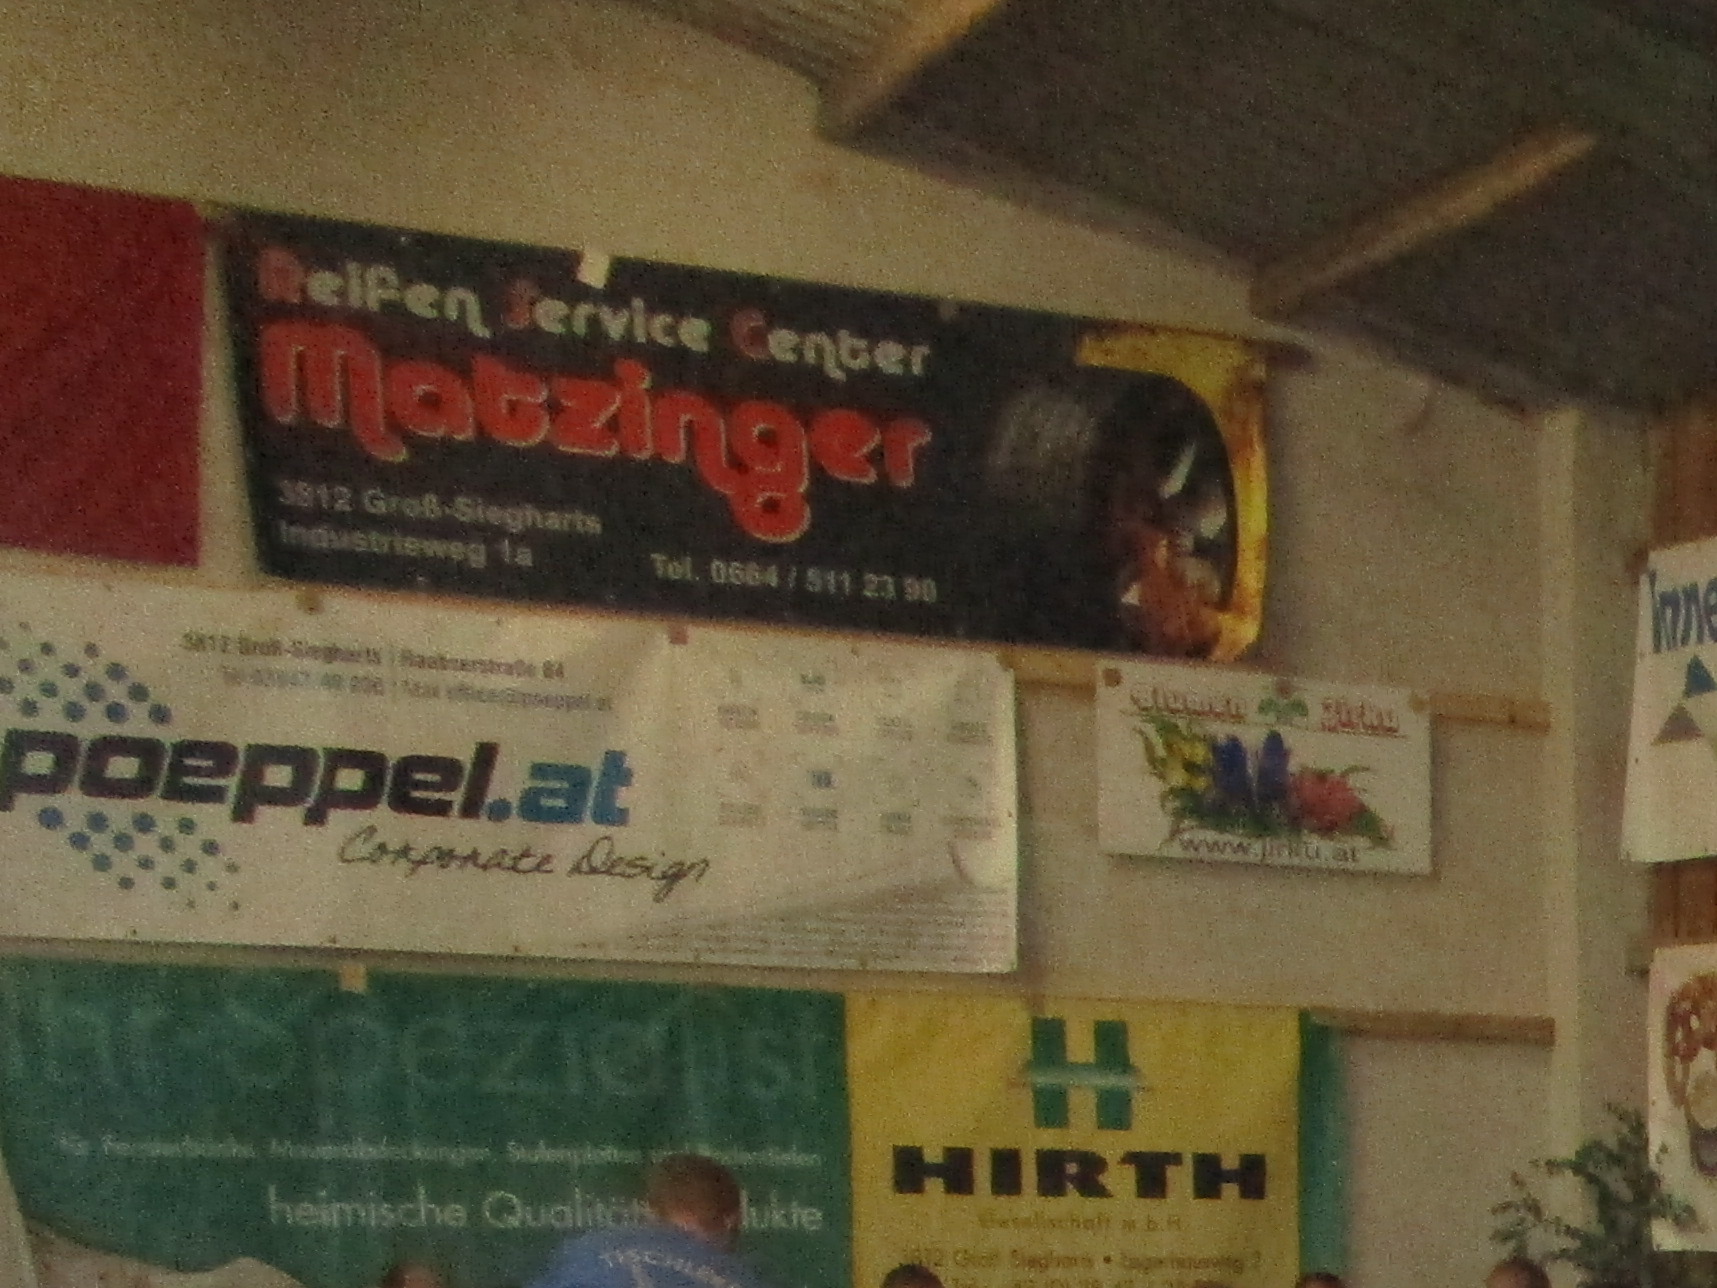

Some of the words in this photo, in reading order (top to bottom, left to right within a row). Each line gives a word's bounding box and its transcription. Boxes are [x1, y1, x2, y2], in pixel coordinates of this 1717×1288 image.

[259, 248, 491, 338] Reifen
[504, 279, 712, 352] Service
[729, 309, 931, 382] Center
[260, 319, 932, 544] Matzinger
[649, 552, 702, 582] Tel.
[0, 727, 634, 827] poeppel.at
[338, 825, 556, 879] Corporate
[568, 836, 711, 904] Design
[268, 1184, 467, 1230] heimische
[892, 1144, 1267, 1200] HIRTH
